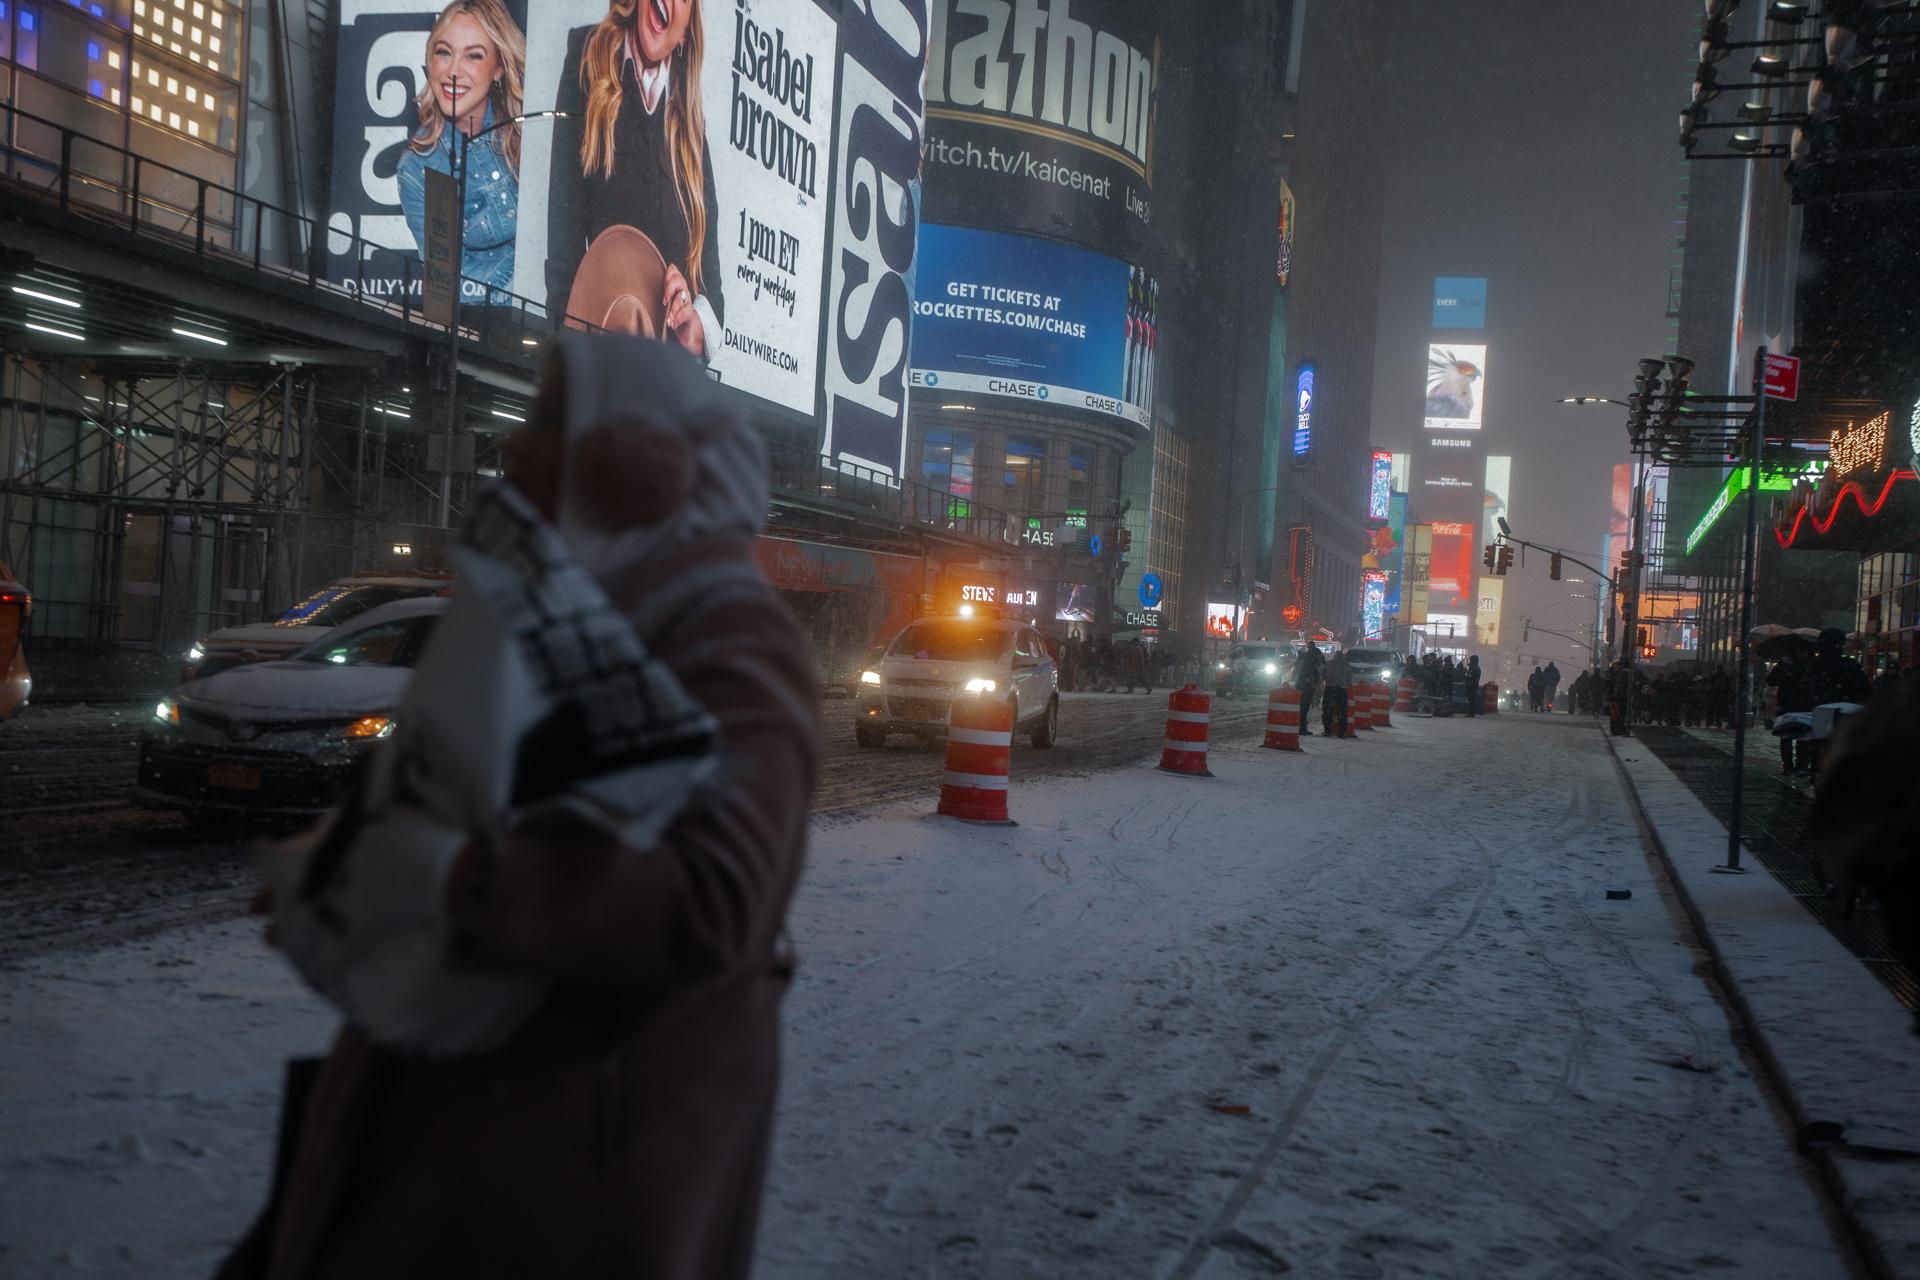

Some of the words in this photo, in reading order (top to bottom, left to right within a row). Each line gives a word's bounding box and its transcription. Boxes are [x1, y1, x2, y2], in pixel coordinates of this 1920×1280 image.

[733, 0, 814, 125] isabel
[730, 70, 817, 200] brown
[1125, 185, 1143, 219] Live
[738, 207, 747, 249] 1
[747, 217, 776, 265] pm
[777, 230, 799, 277] ET
[737, 264, 762, 302] every
[763, 275, 797, 319] weekday
[947, 281, 978, 298] GET
[982, 286, 1041, 308] TICKETS
[1043, 296, 1061, 311] AT
[913, 300, 1086, 339] ROCKETTES.COM/CHASE
[724, 327, 799, 375] DAILYWIRE.COM
[988, 379, 1036, 397] CHASE
[1085, 395, 1116, 413] CHASE
[1431, 438, 1472, 447] SAMSUNG
[962, 585, 995, 602] STEVE
[1126, 612, 1159, 627] CHASE
